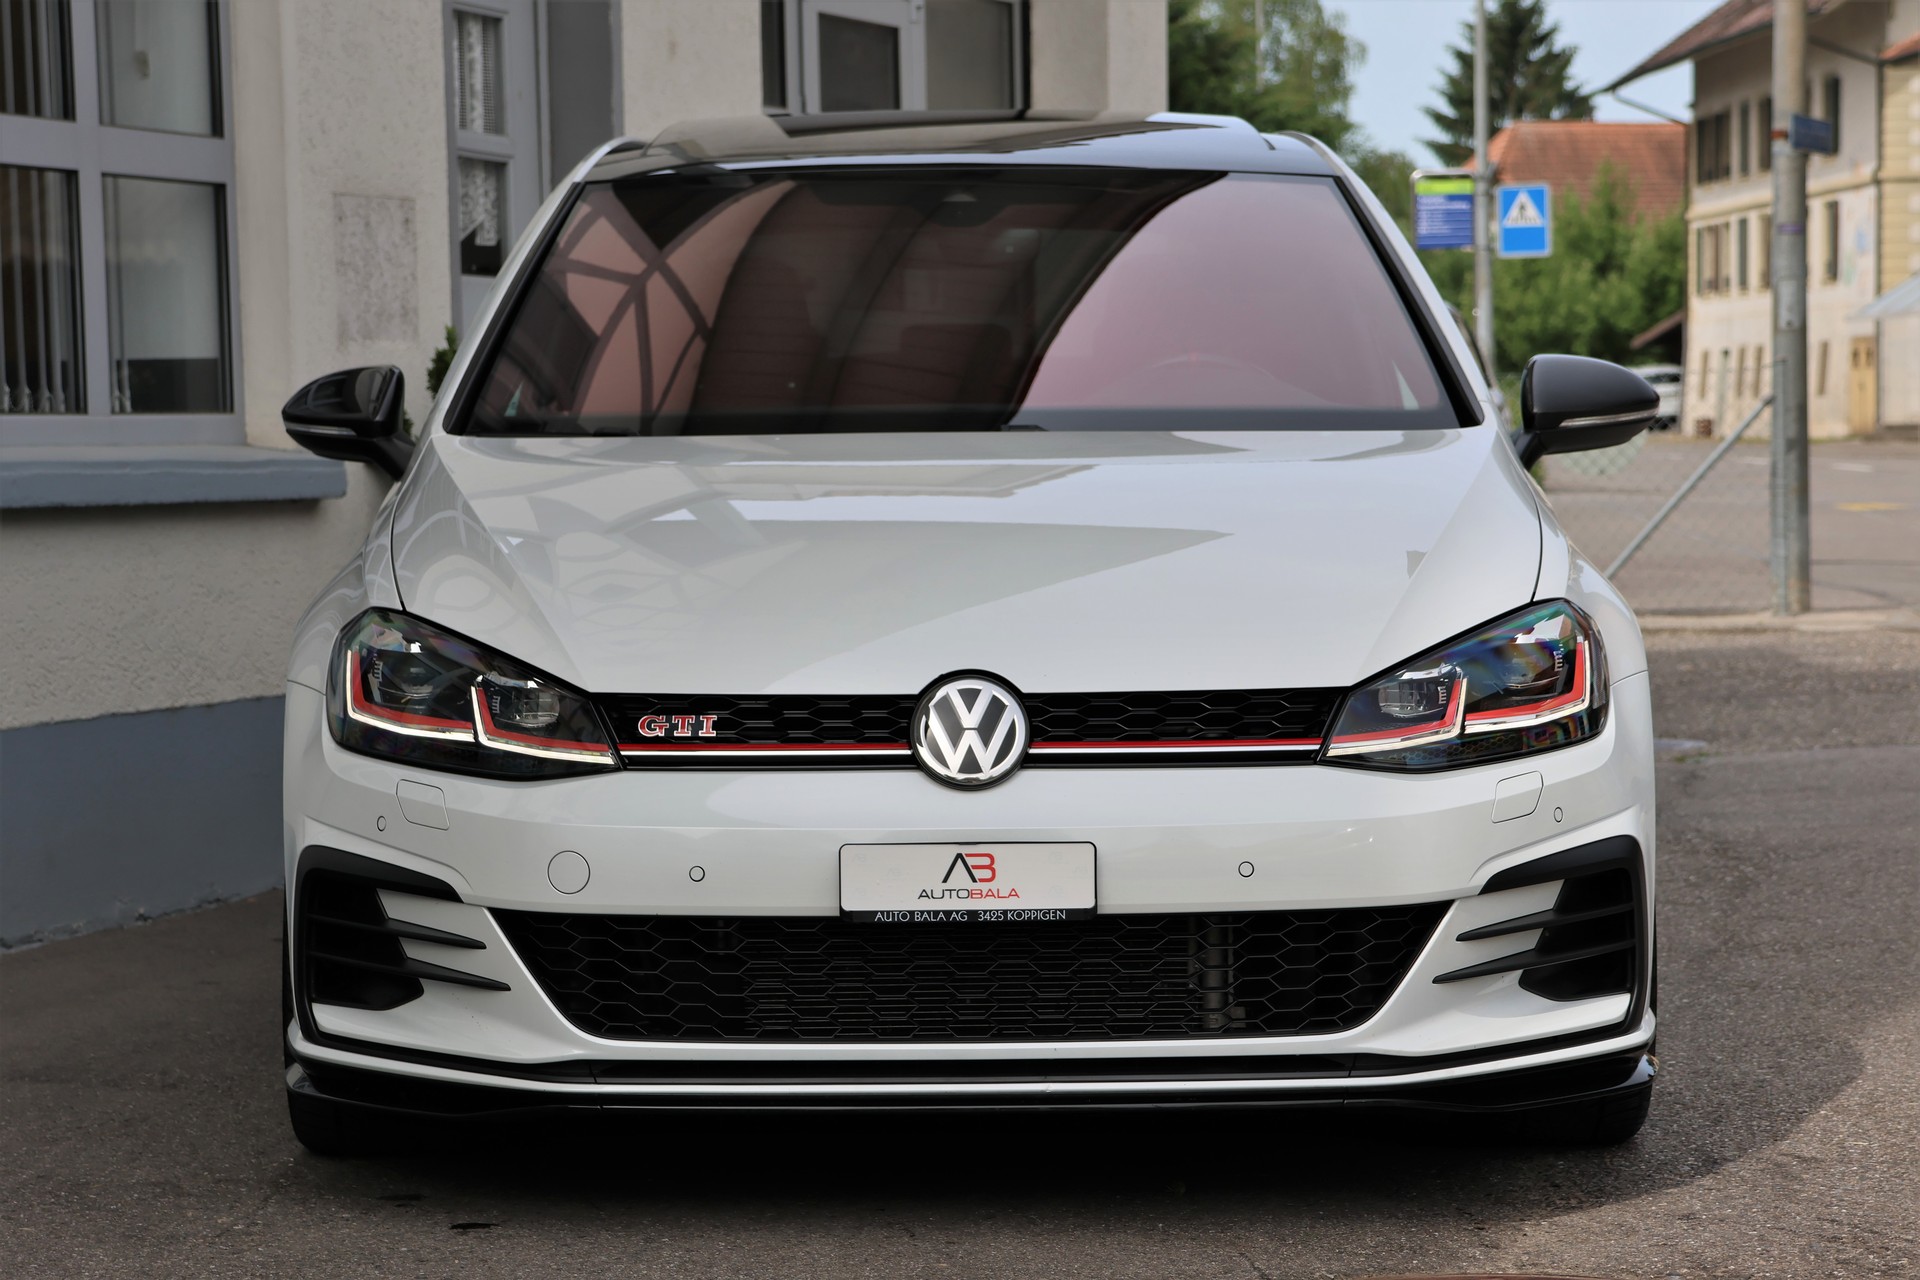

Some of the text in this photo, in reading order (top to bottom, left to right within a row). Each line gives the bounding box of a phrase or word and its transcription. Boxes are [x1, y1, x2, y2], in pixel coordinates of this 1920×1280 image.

[637, 714, 718, 737] GTI
[917, 888, 1020, 899] AUTOBALA
[874, 909, 1066, 922] AUTO BALA AG 3425 KOPPIGEN
